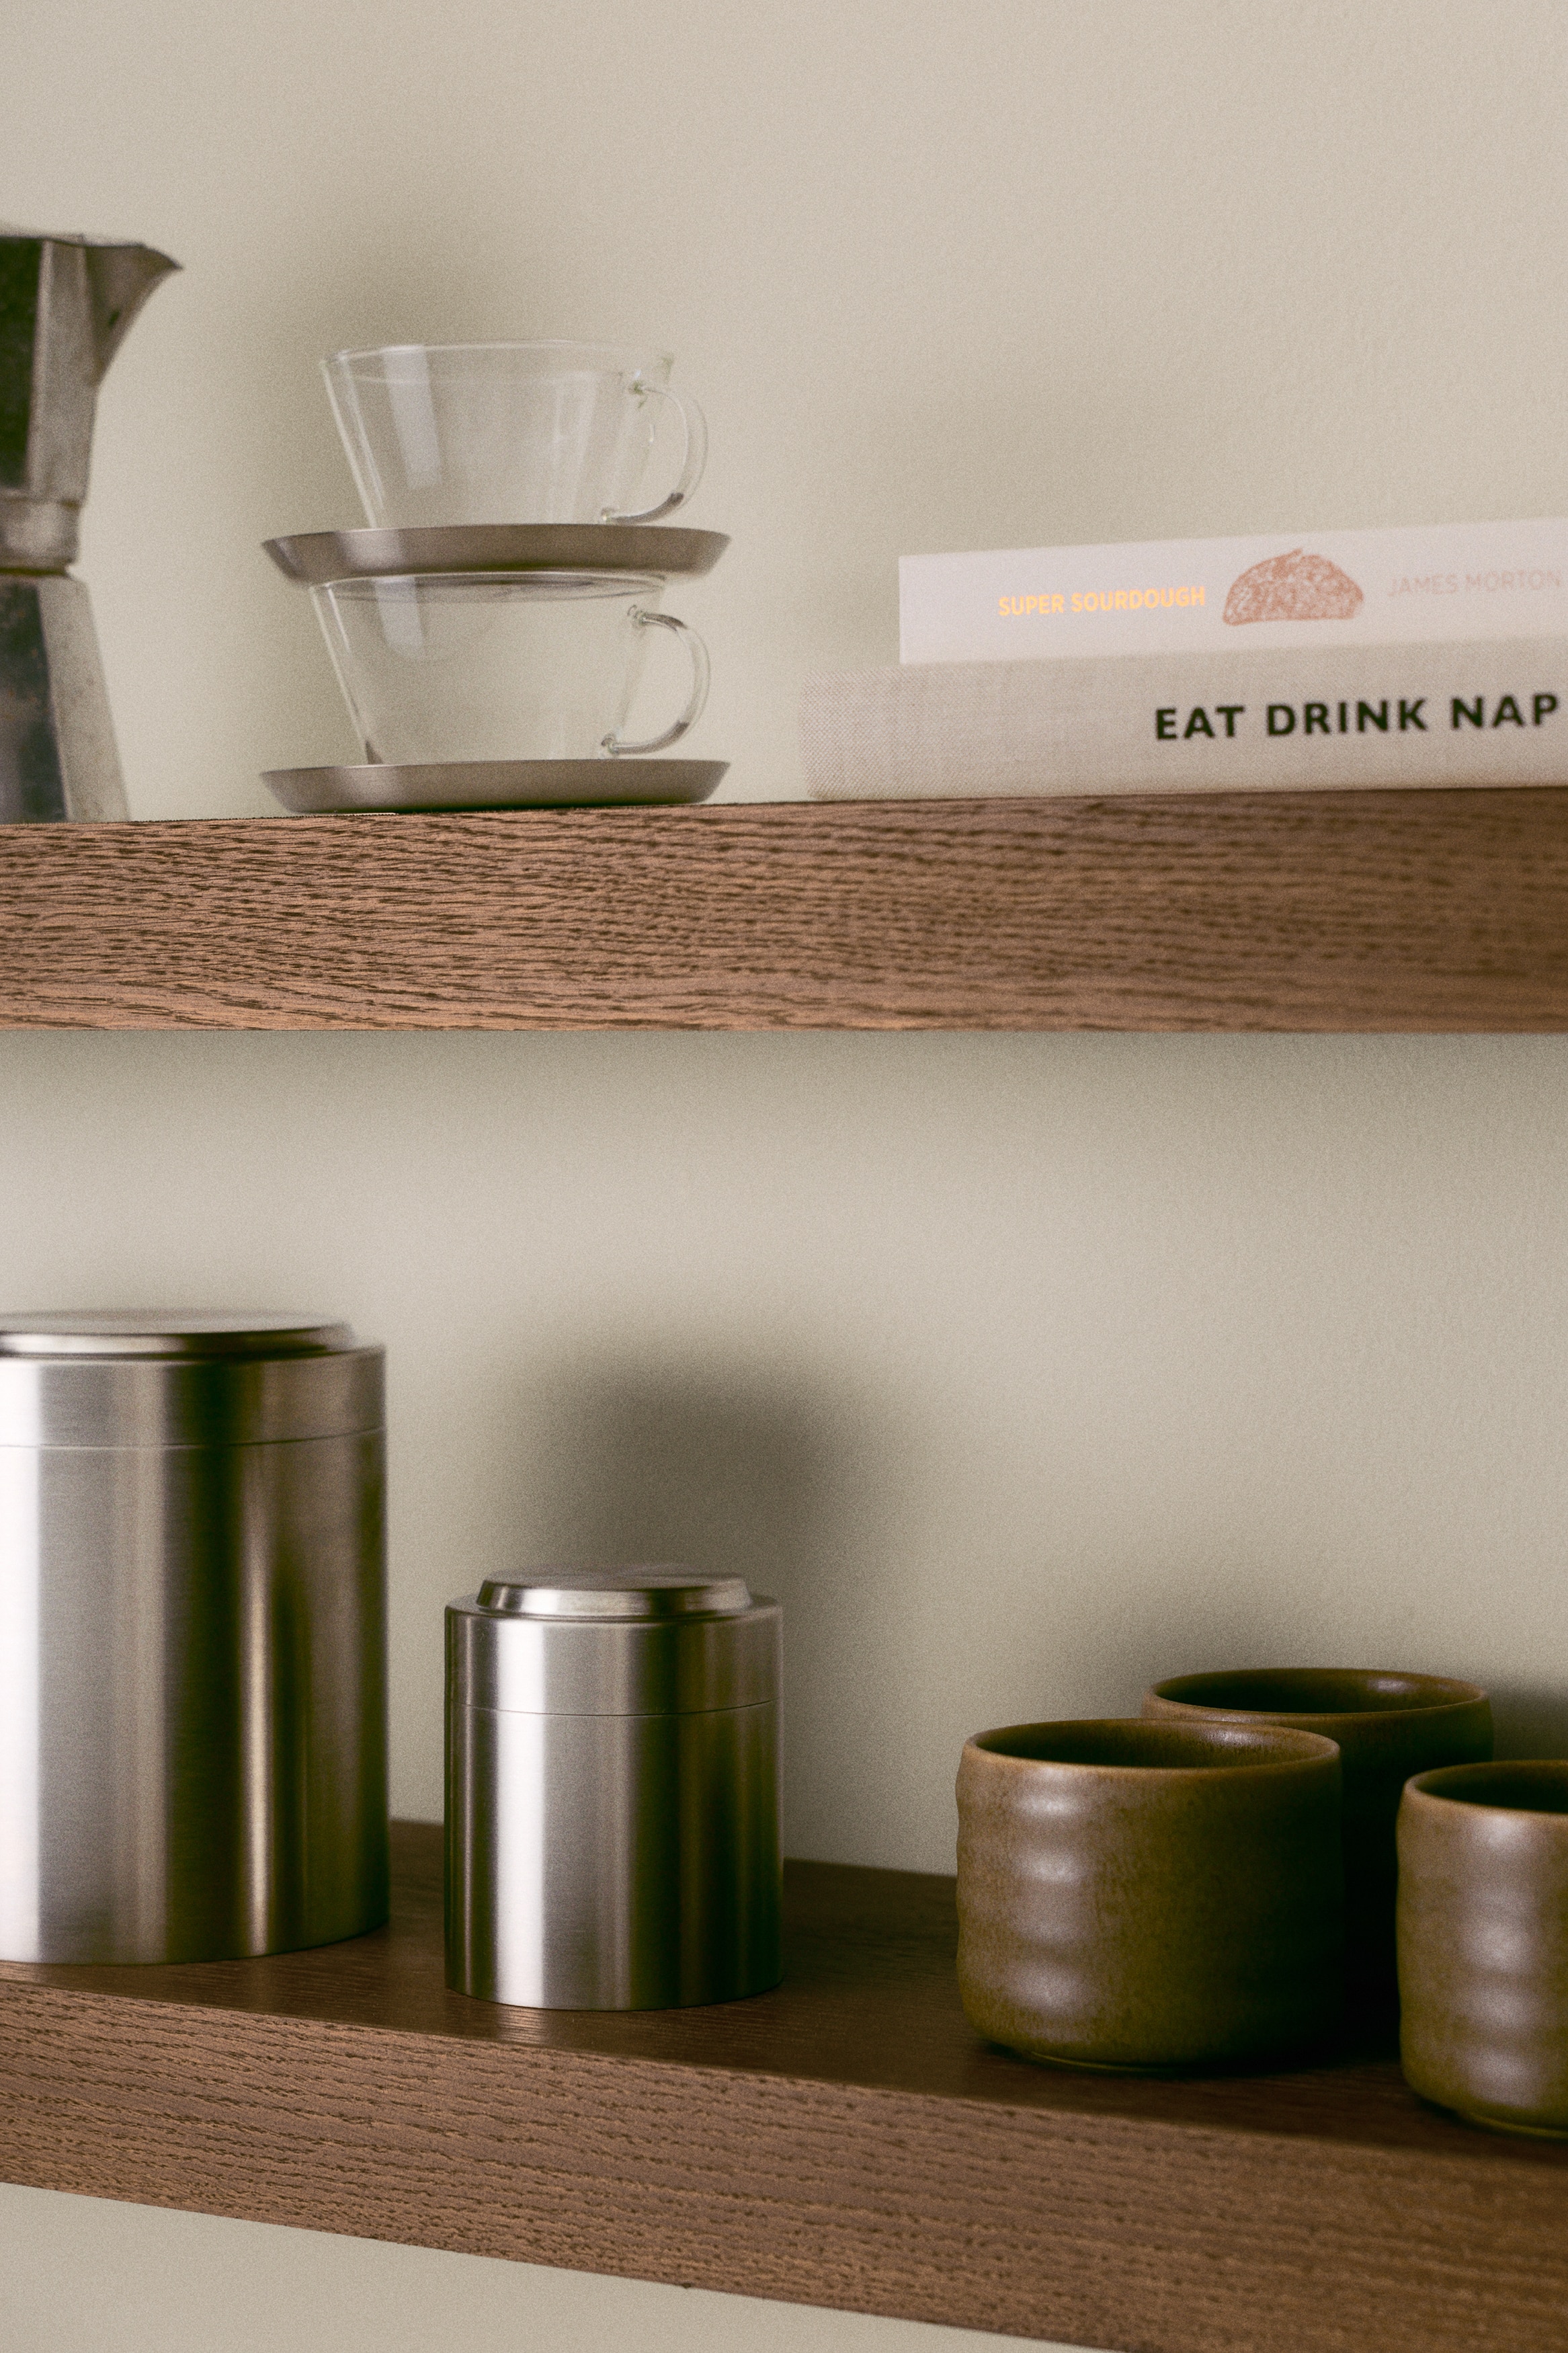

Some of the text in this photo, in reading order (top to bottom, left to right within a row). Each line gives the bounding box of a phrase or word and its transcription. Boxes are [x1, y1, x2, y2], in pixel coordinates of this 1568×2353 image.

[1388, 569, 1561, 597] JAMES MORTON
[998, 586, 1206, 616] SUPER SOURDOUGH
[1155, 693, 1559, 740] EAT DRINK NAP
